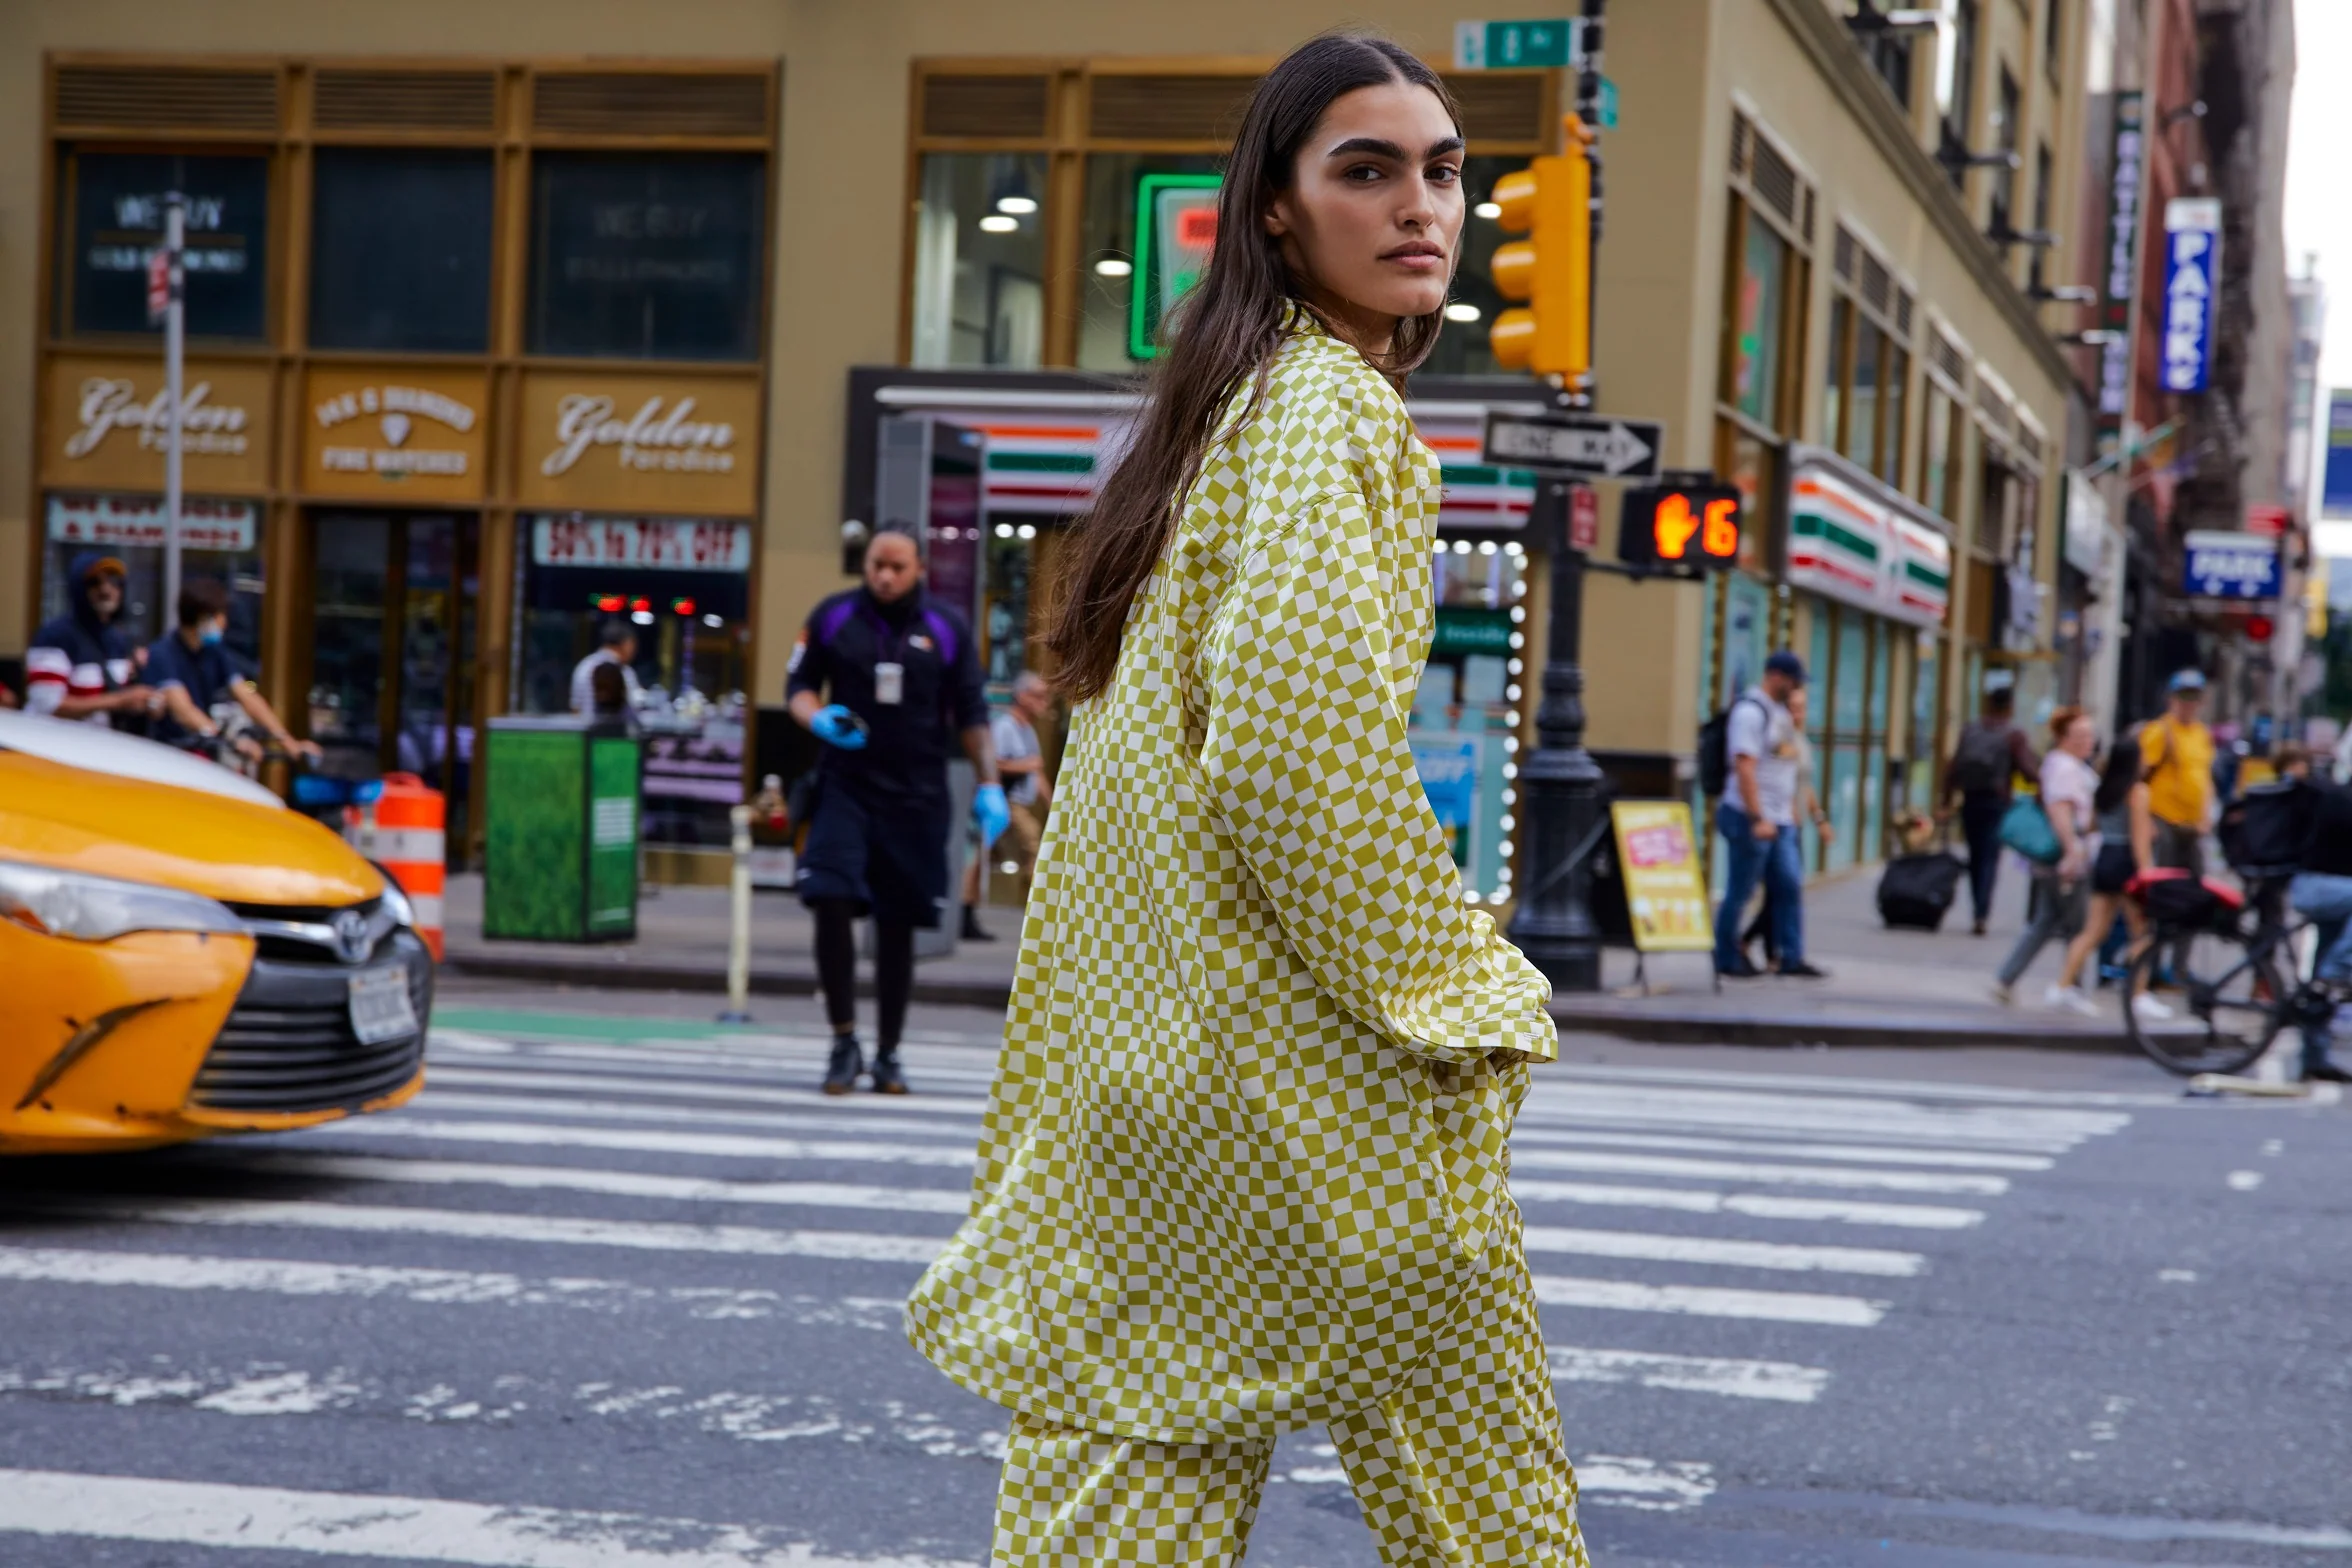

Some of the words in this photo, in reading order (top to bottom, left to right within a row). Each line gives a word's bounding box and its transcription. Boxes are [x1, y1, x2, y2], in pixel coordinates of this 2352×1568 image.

[65, 377, 248, 458] Golden
[541, 394, 734, 476] Golden
[1510, 431, 1554, 453] ONE
[1584, 435, 1634, 461] WAY
[94, 523, 242, 546] DIAMNDS
[1702, 498, 1739, 558] 6
